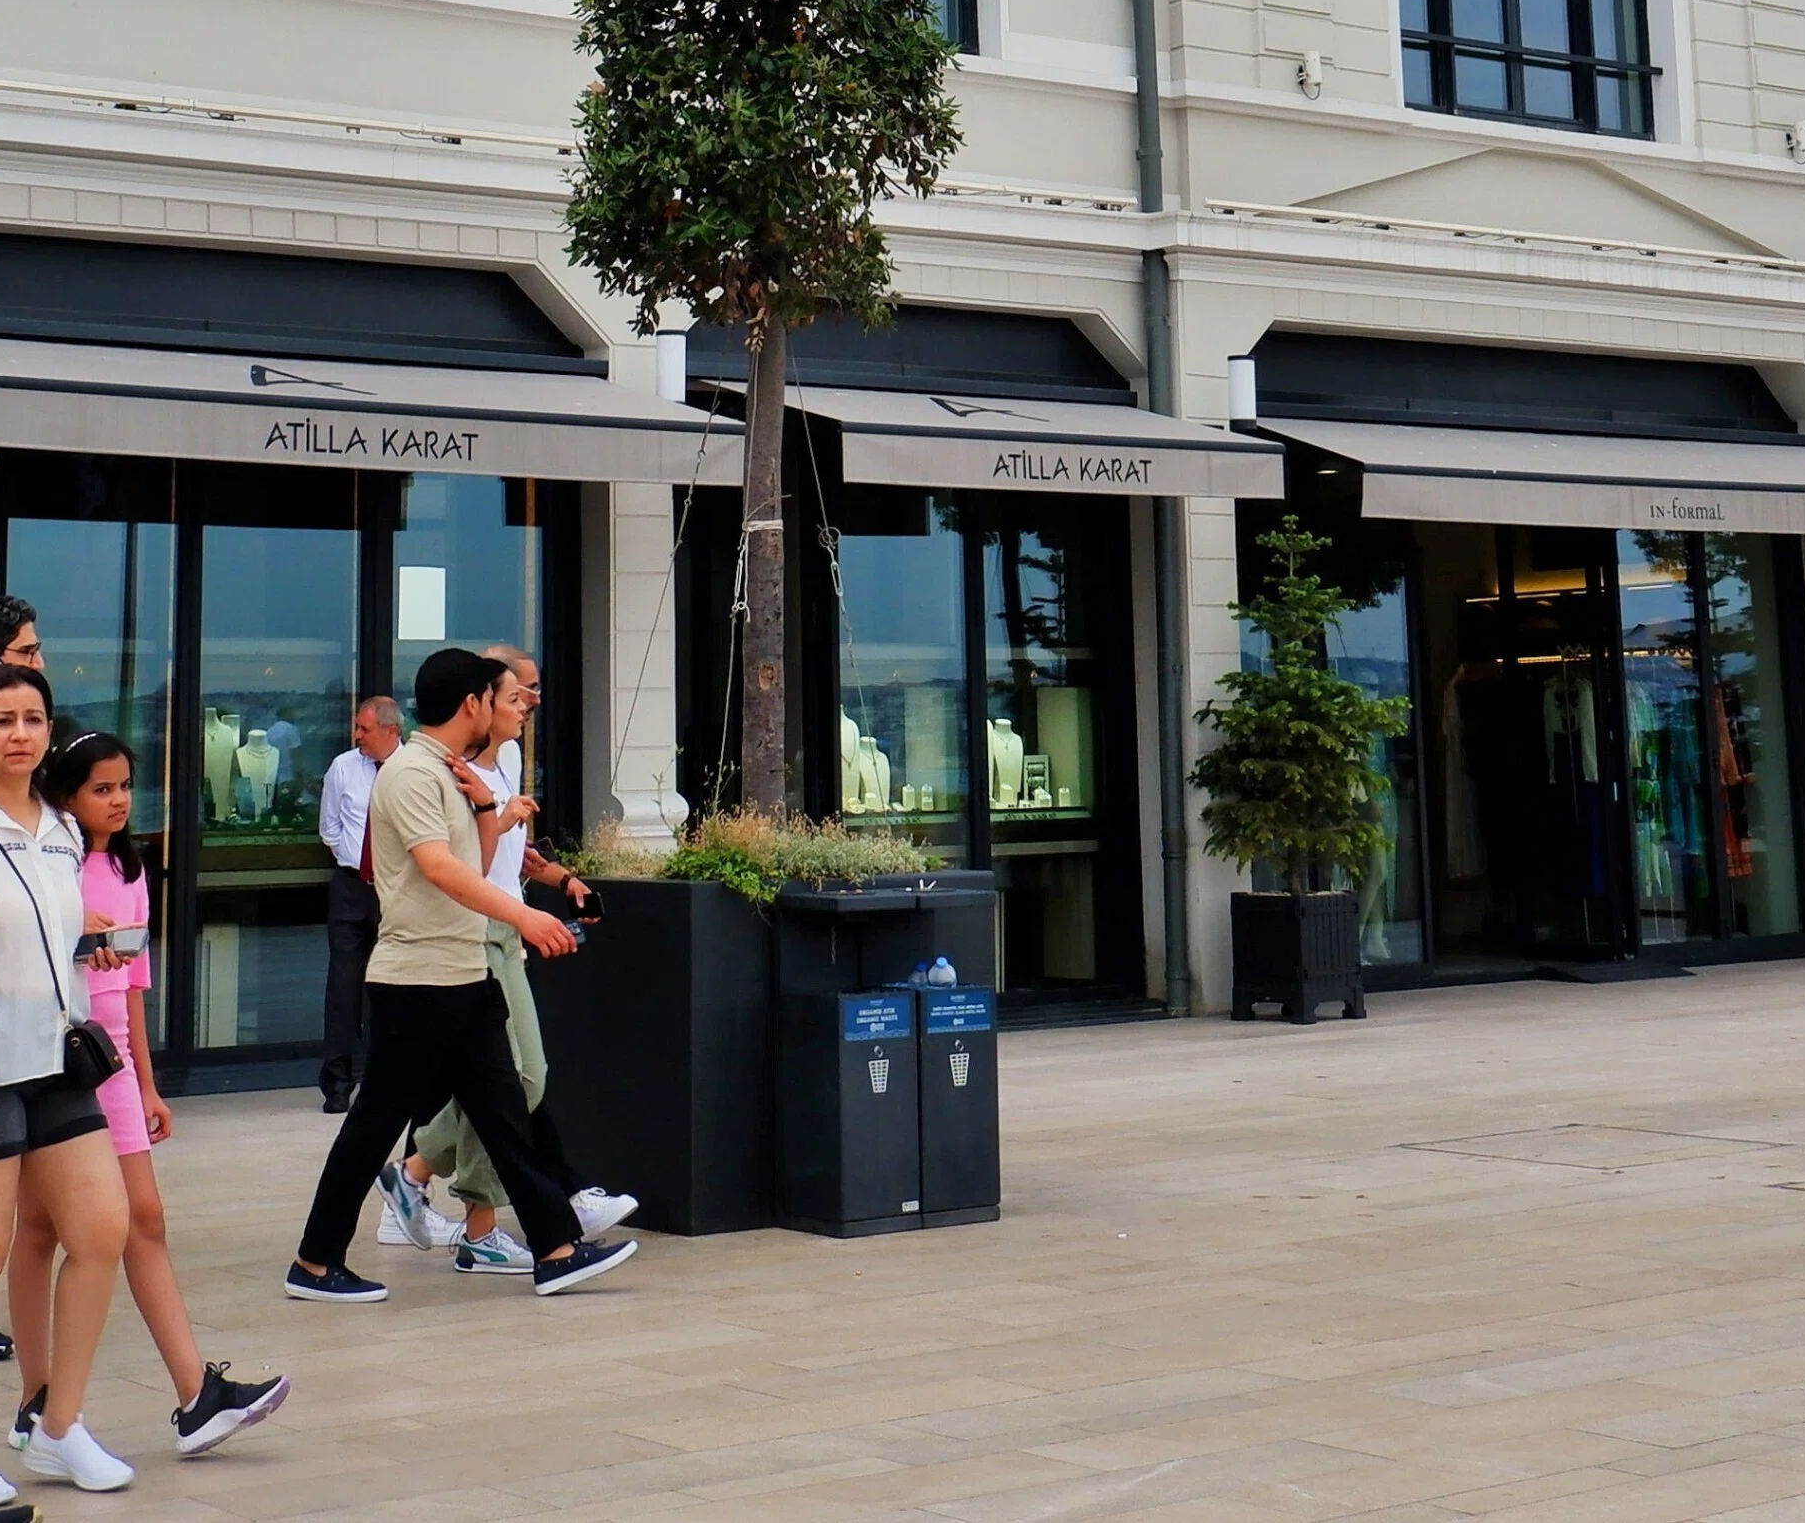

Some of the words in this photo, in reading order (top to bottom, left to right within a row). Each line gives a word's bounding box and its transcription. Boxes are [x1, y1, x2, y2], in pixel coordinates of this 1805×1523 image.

[264, 417, 368, 455] ATİLLA
[382, 427, 479, 462] KARAT
[993, 449, 1069, 481] ATİLLA
[1079, 456, 1152, 485] KARAT
